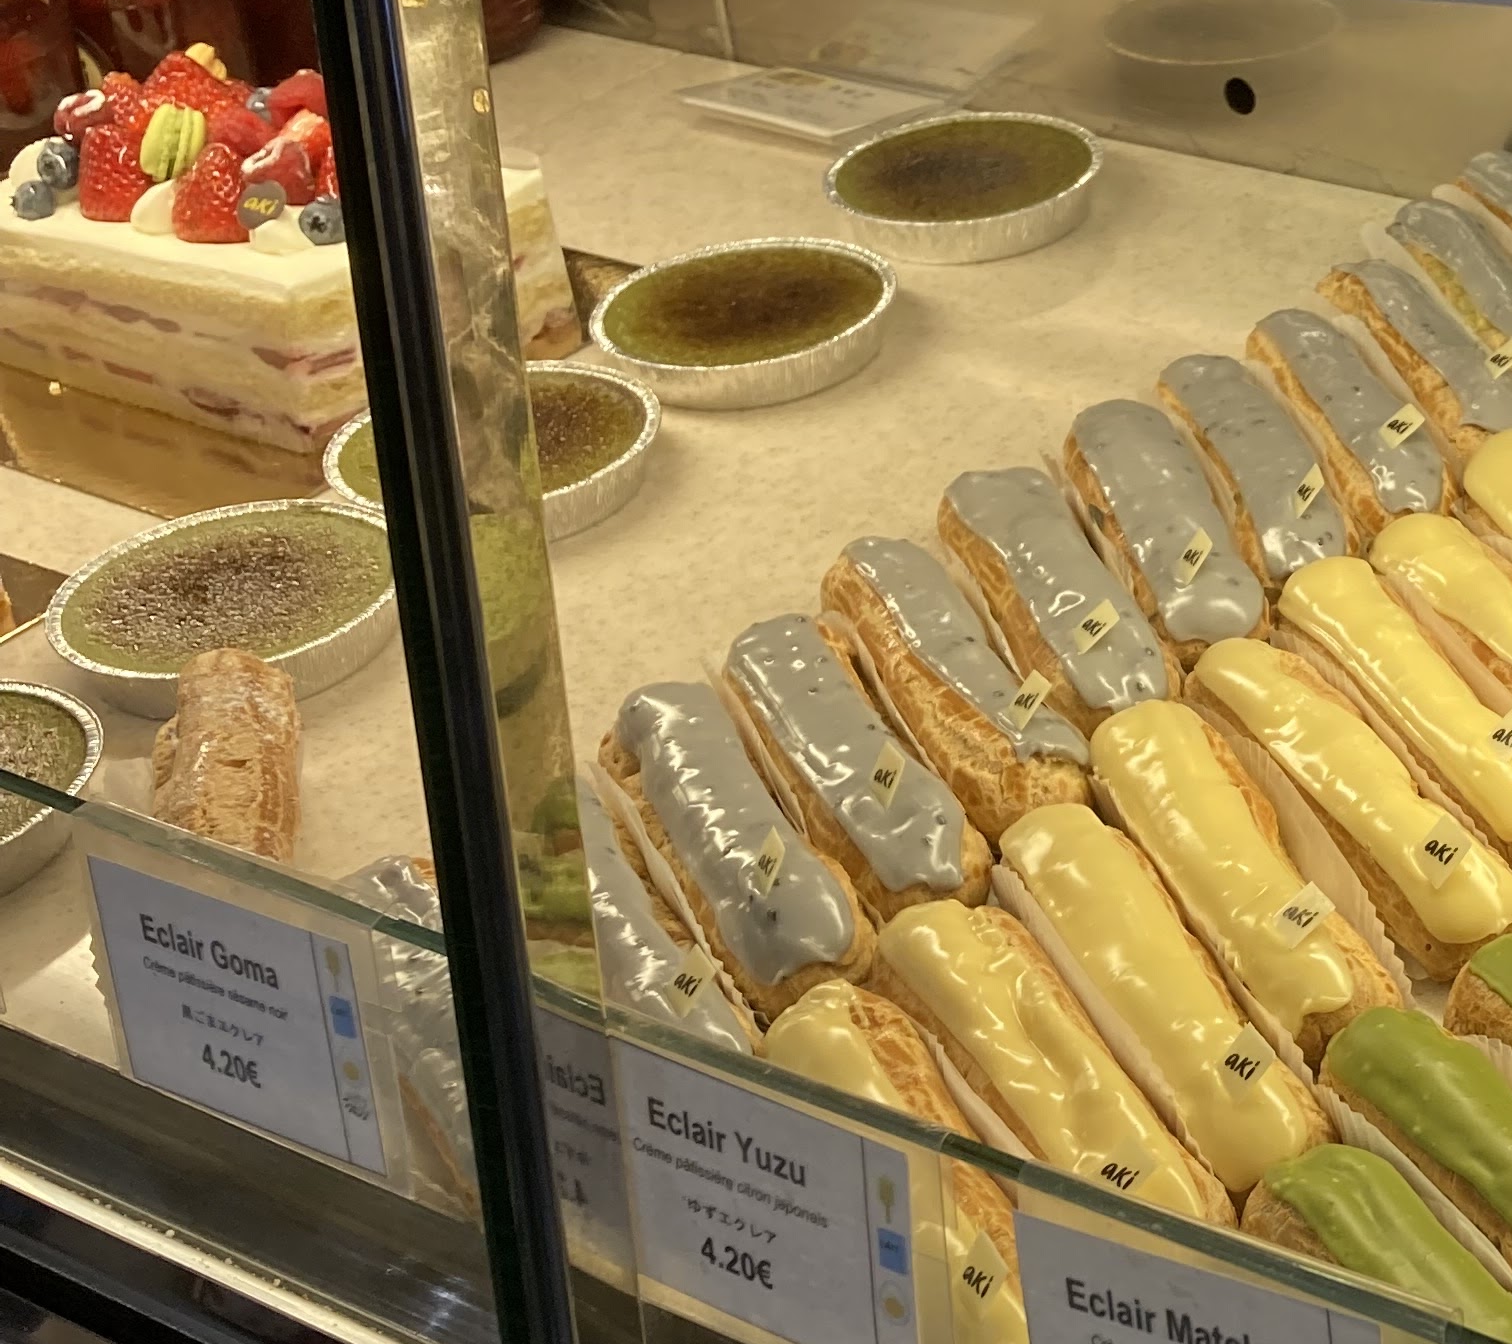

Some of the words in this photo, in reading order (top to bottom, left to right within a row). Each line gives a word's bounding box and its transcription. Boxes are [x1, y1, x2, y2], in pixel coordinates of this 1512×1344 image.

[139, 913, 204, 961] Eclair
[210, 940, 279, 989] Goma
[202, 1044, 262, 1088] 4.20€
[646, 1096, 727, 1153] Eclair
[734, 1130, 807, 1187] Yuzu
[700, 1236, 774, 1290] 4.20€
[1065, 1276, 1156, 1334] Eclair
